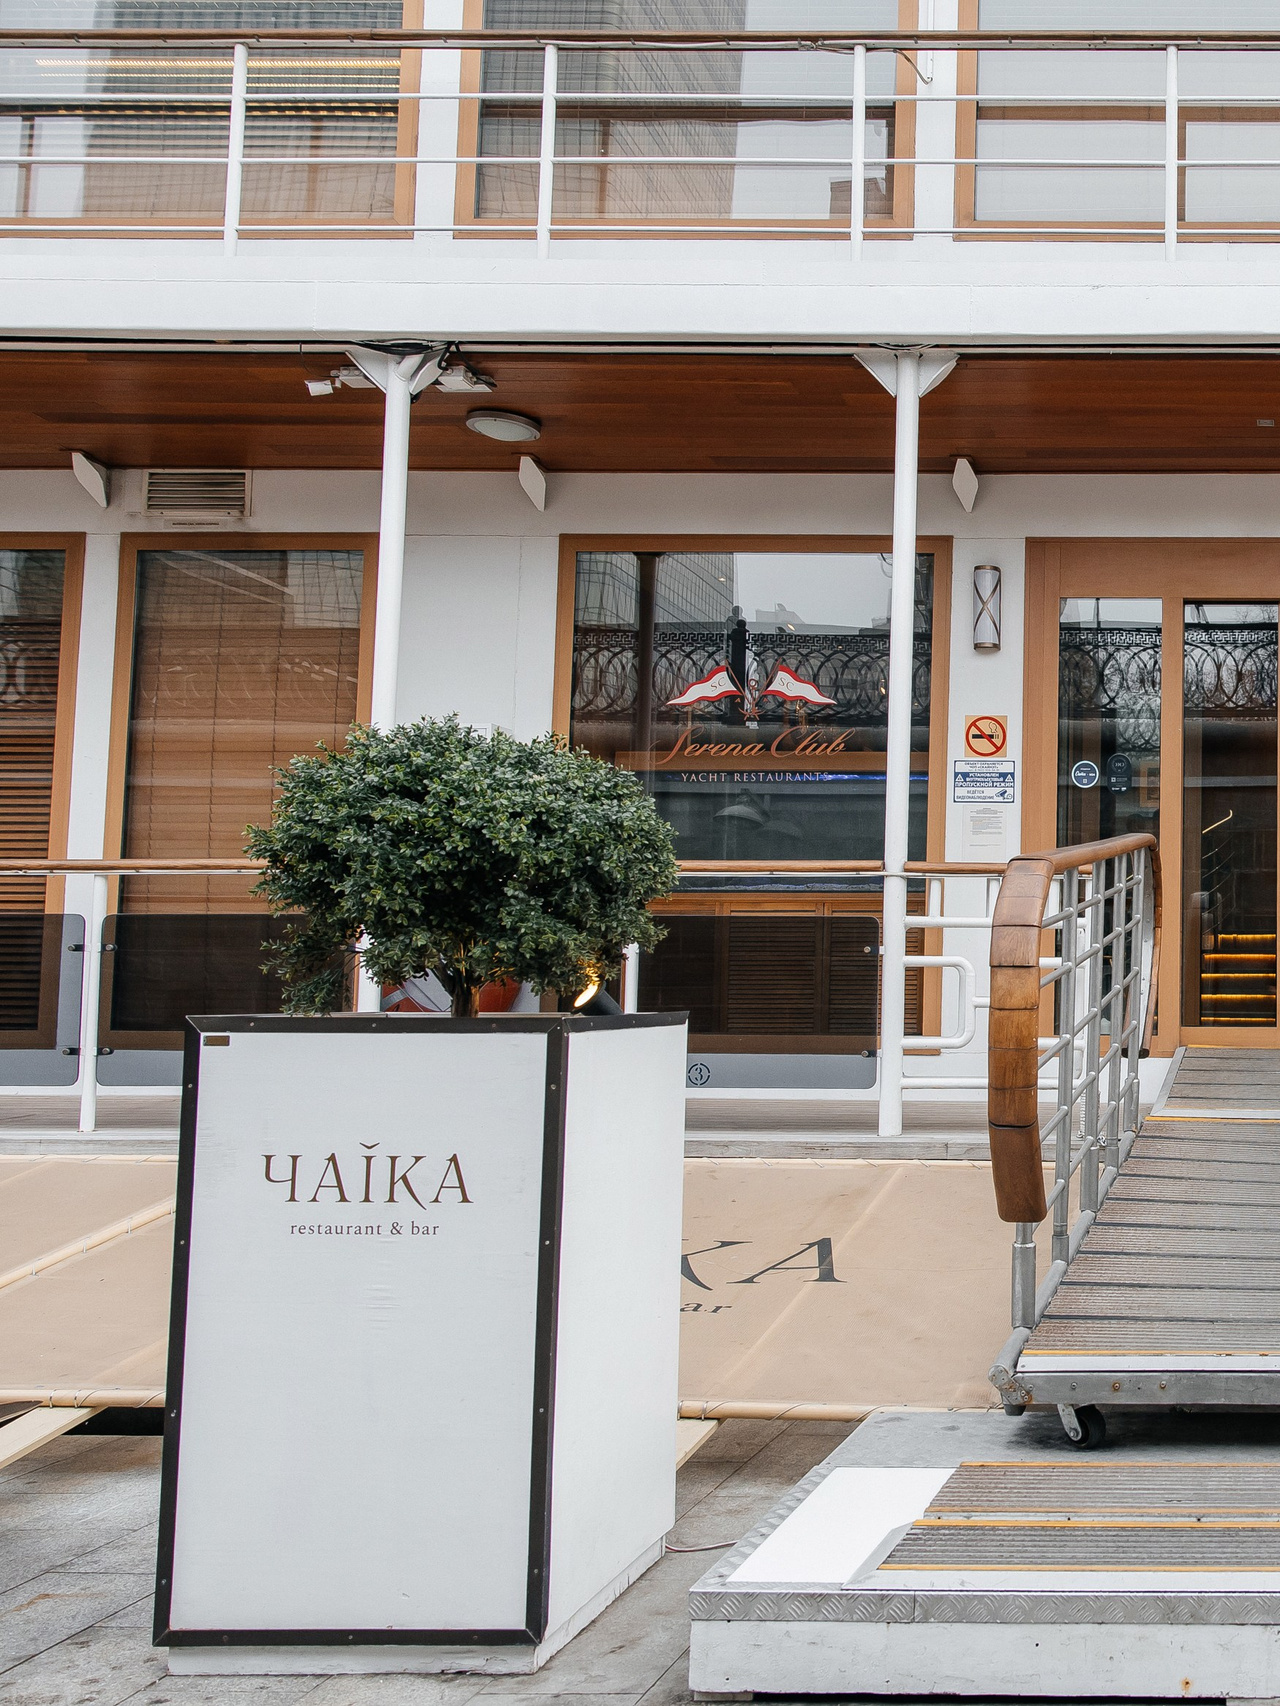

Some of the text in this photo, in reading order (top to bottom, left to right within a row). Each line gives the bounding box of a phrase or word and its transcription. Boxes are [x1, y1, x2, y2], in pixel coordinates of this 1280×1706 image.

[710, 676, 726, 692] SC
[778, 677, 795, 692] SC
[647, 725, 856, 765] Serena Club
[681, 772, 829, 782] YACHT RESTAURANTS
[290, 1220, 440, 1236] restaurant & bar
[680, 1302, 733, 1314] ar
